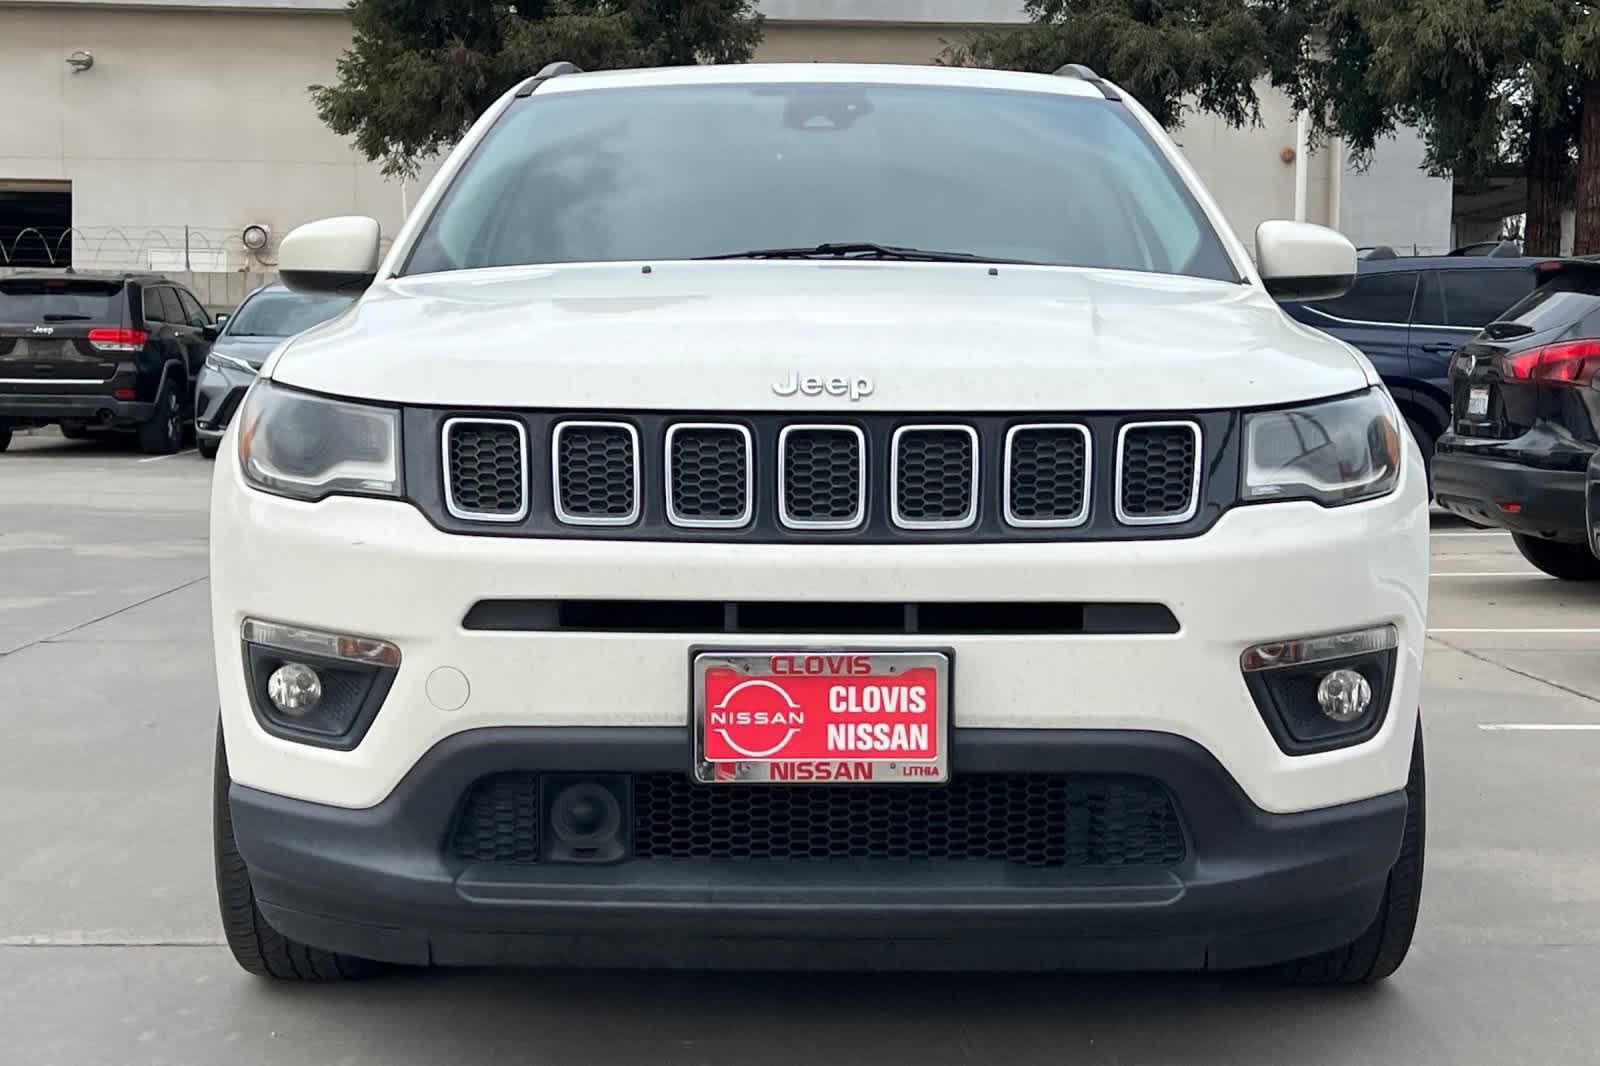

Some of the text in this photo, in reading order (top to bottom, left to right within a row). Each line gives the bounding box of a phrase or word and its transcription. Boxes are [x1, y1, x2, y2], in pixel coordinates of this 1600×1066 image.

[32, 326, 54, 334] Jeep
[771, 369, 874, 401] Jeep
[771, 656, 872, 675] CLOVIS
[829, 685, 926, 713] CLOVIS
[711, 712, 804, 724] NISSAN
[827, 723, 928, 751] NISSAN
[769, 761, 872, 781] NISSAN
[903, 766, 939, 777] LITHIA
